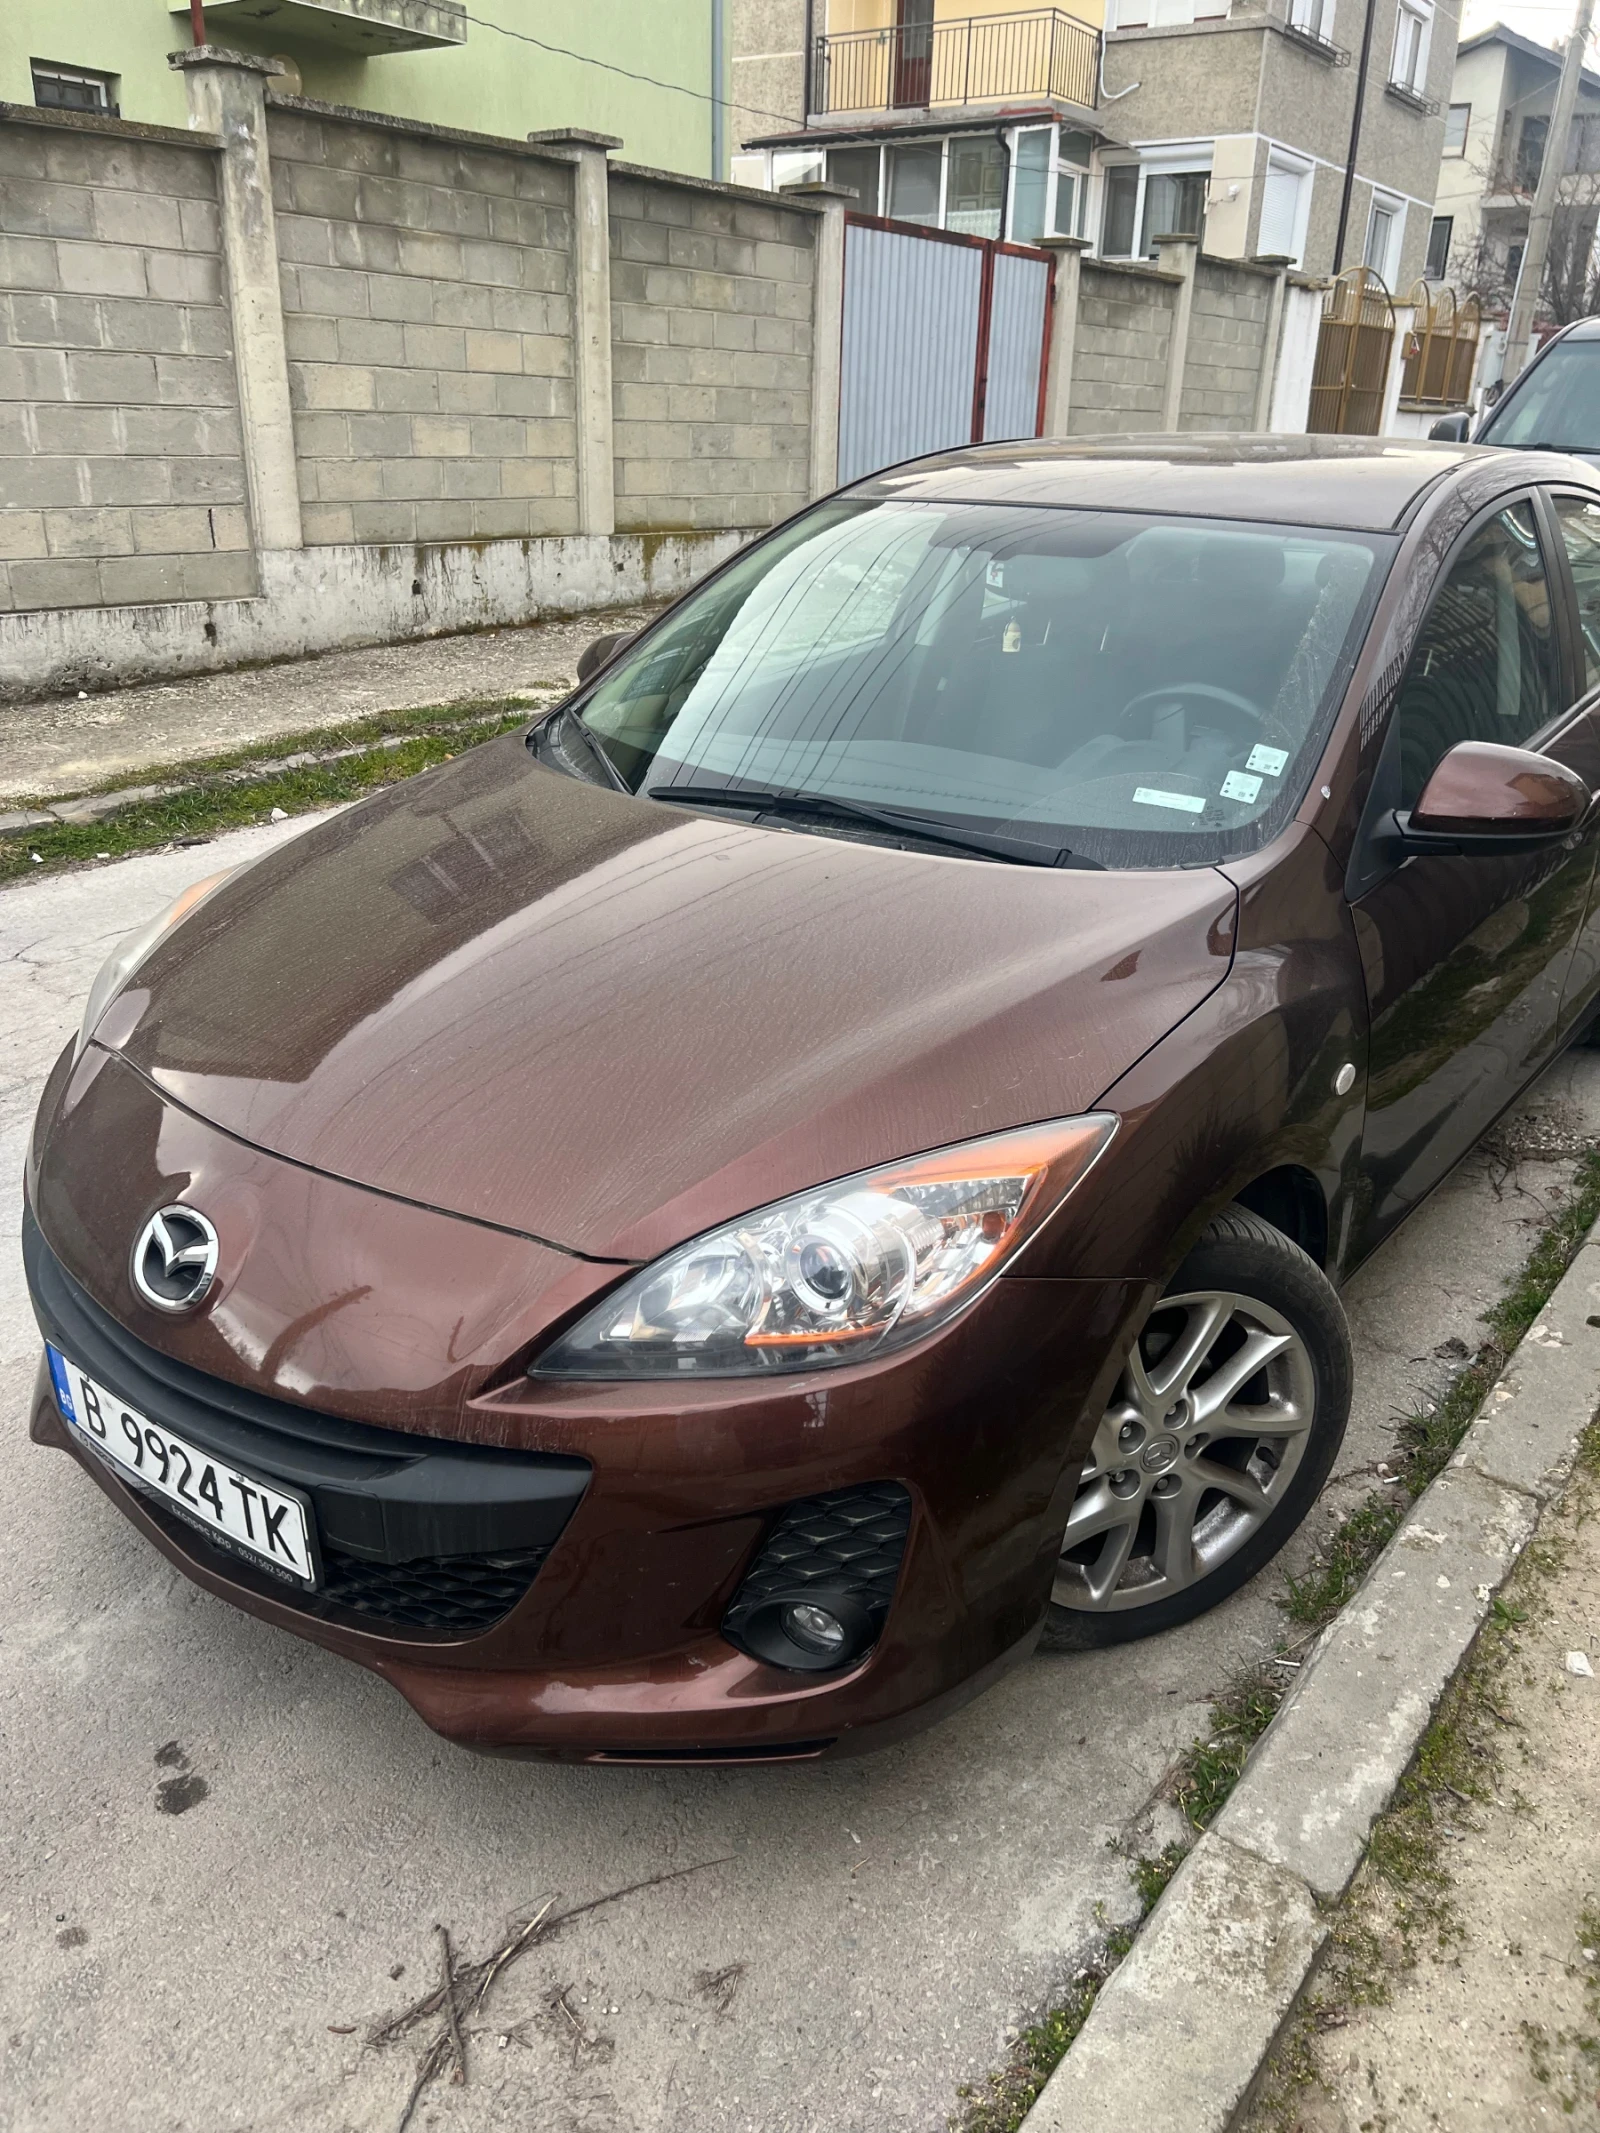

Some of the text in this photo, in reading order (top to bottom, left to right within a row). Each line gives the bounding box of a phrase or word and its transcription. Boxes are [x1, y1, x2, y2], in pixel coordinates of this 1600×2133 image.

[59, 1387, 74, 1410] BG
[80, 1376, 299, 1566] B 9924 TK
